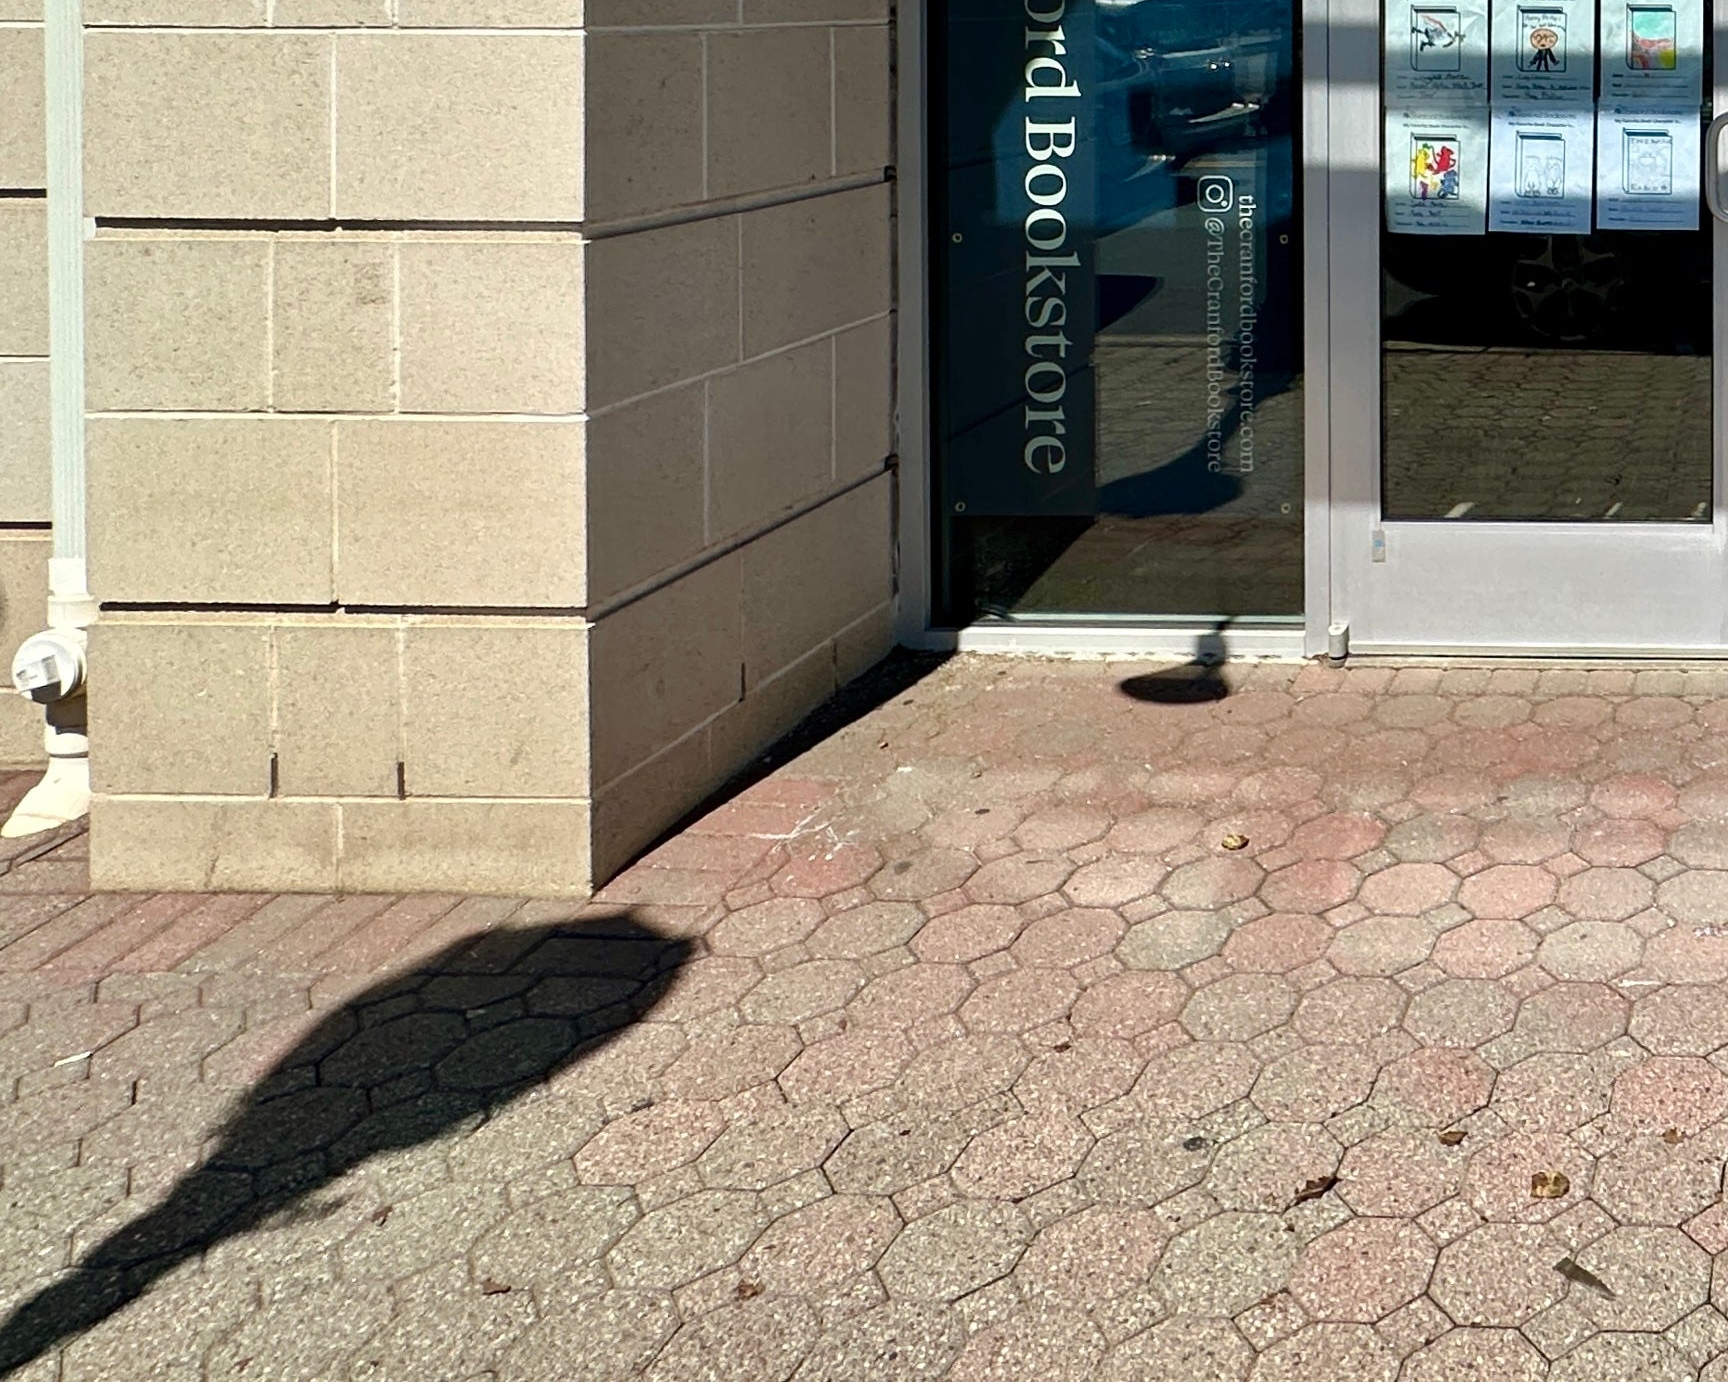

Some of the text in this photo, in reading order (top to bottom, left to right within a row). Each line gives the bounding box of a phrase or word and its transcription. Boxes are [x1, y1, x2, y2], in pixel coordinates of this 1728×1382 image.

[1024, 117, 1081, 475] Bookstore
[1204, 217, 1224, 473] @TheCranfordBookstore
[1238, 195, 1257, 473] thecranfordbookstore.com
